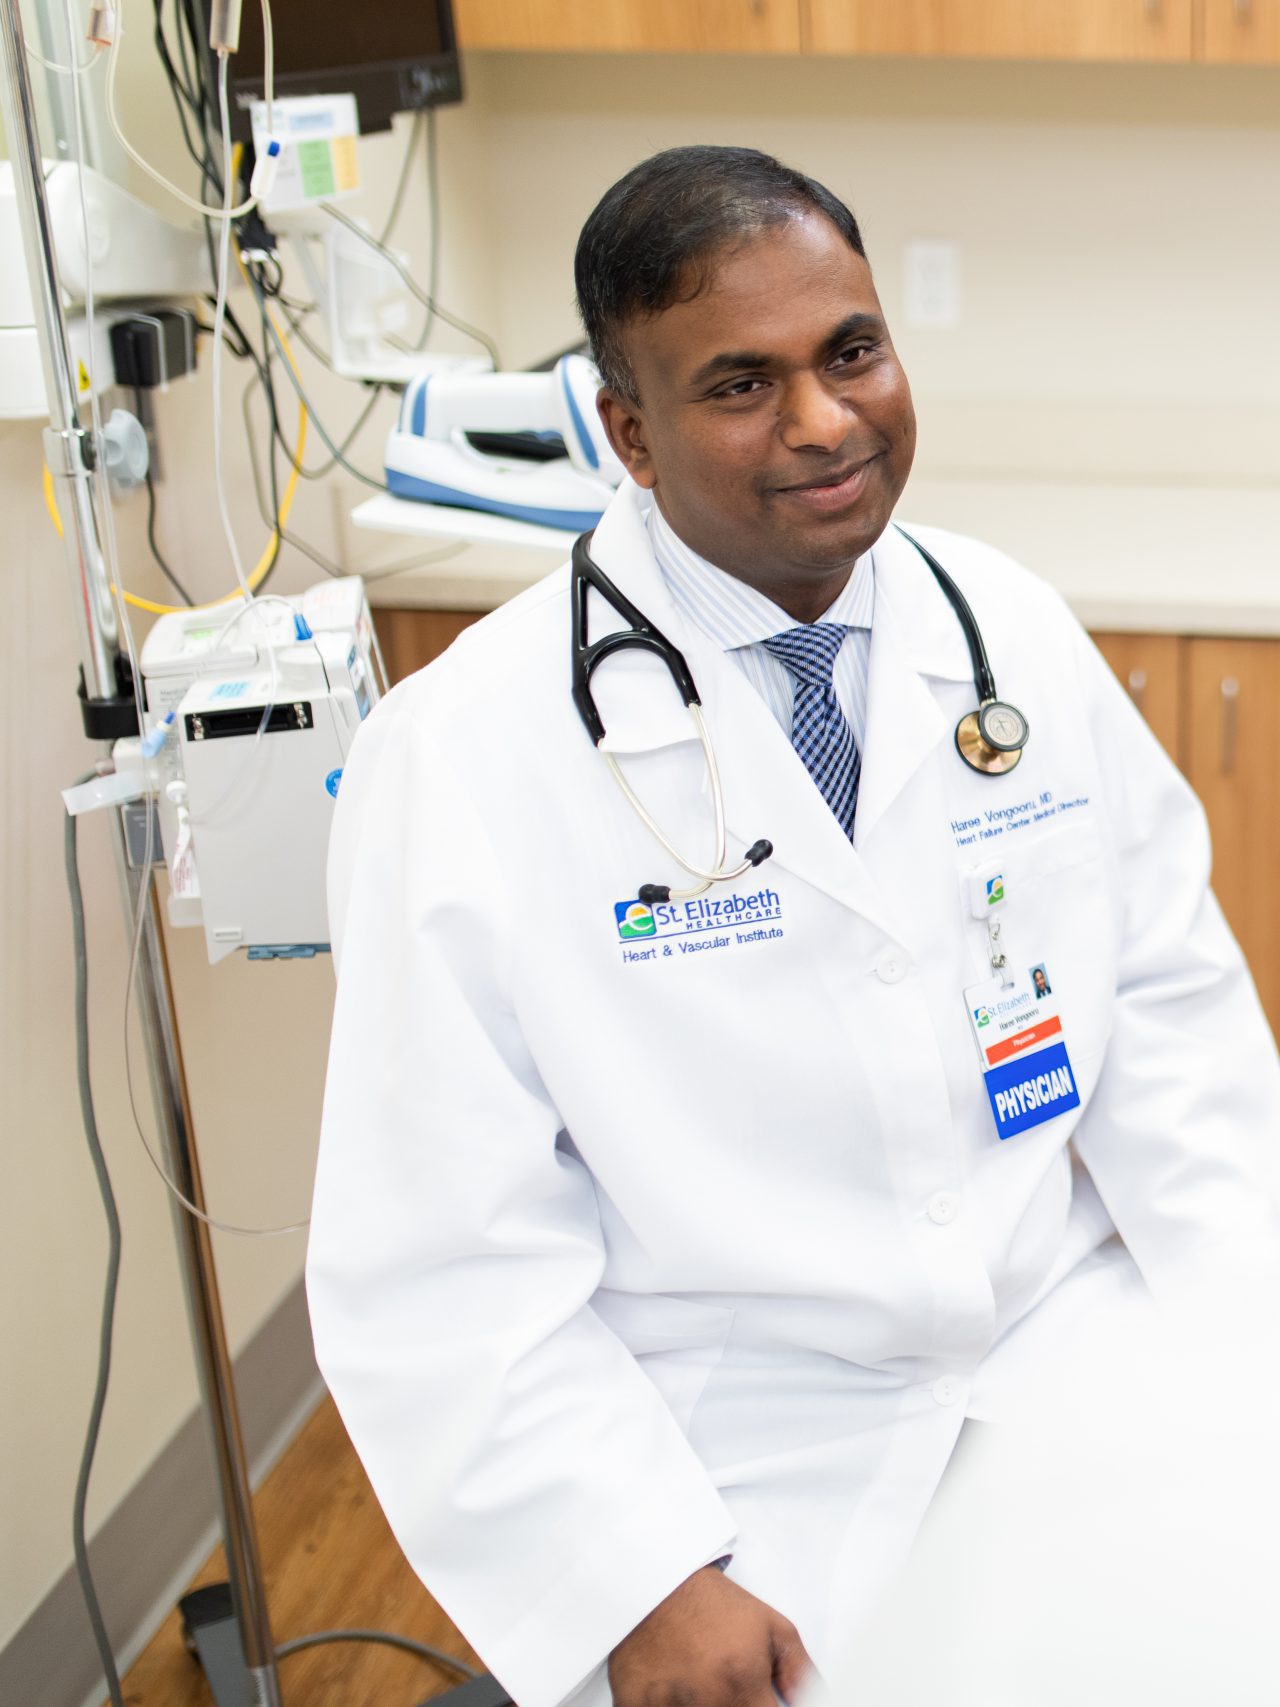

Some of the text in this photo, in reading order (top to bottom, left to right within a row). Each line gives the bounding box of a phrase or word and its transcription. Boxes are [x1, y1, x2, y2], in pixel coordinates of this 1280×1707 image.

[951, 817, 980, 833] Haree
[1039, 791, 1052, 806] MD
[956, 834, 977, 847] Heart
[980, 827, 1003, 840] Failure
[685, 888, 780, 920] Elizabeth
[686, 907, 782, 930] HEALTHCARE
[622, 927, 783, 963] Heart & Vascular Institute
[994, 1065, 1074, 1122] PHYSICIAN
